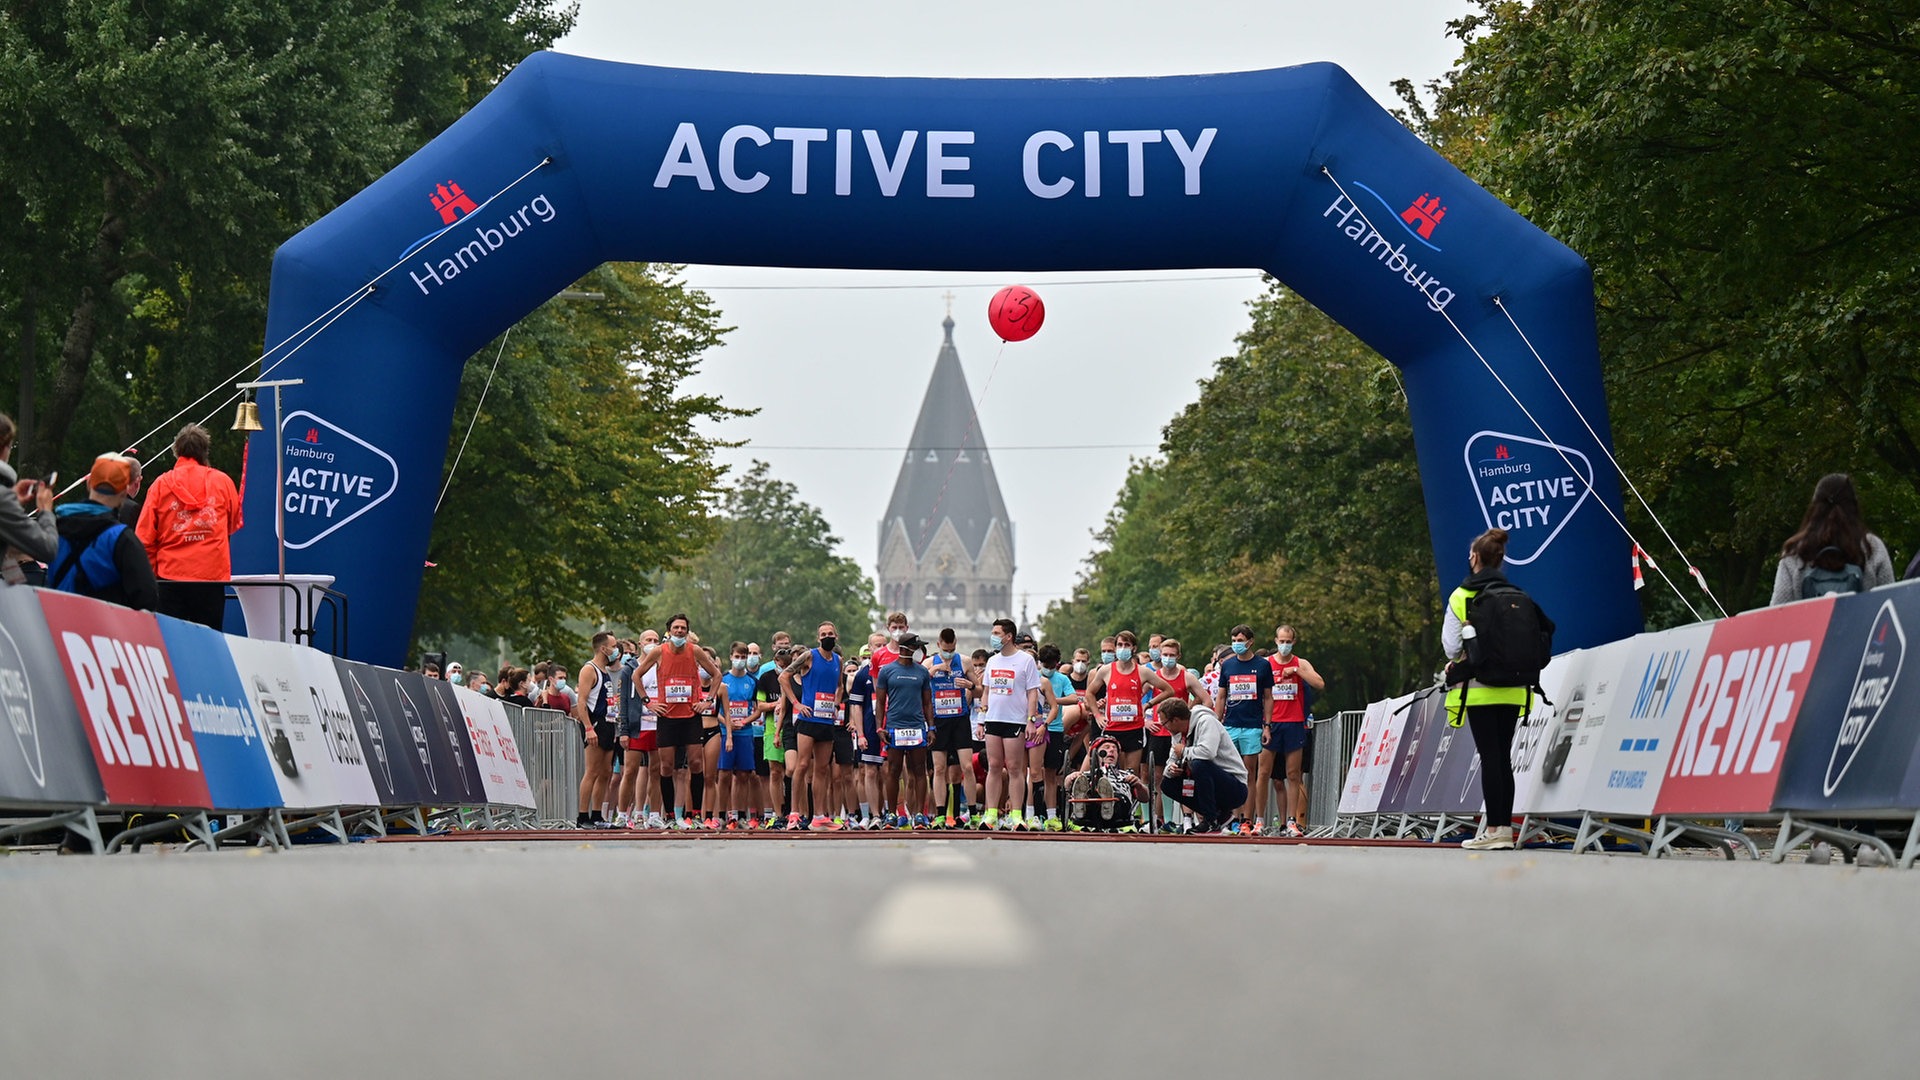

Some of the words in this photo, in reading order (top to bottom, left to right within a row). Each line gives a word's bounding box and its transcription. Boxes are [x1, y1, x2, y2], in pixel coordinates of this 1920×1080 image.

[653, 122, 975, 198] ACTIVE
[1022, 128, 1218, 199] CITY
[409, 194, 556, 295] Hamburg
[1323, 194, 1456, 312] Hamburg
[285, 445, 335, 463] Hamburg
[285, 466, 374, 498] ACTIVE
[1479, 463, 1532, 478] Hamburg
[285, 492, 340, 518] CITY
[1490, 476, 1576, 507] ACTIVE
[1497, 505, 1551, 531] CITY
[1630, 649, 1690, 718] MHV
[1850, 676, 1890, 708] ACTIVE
[62, 631, 199, 772] REWE
[1670, 640, 1811, 778] REWE
[1841, 715, 1867, 746] CITY
